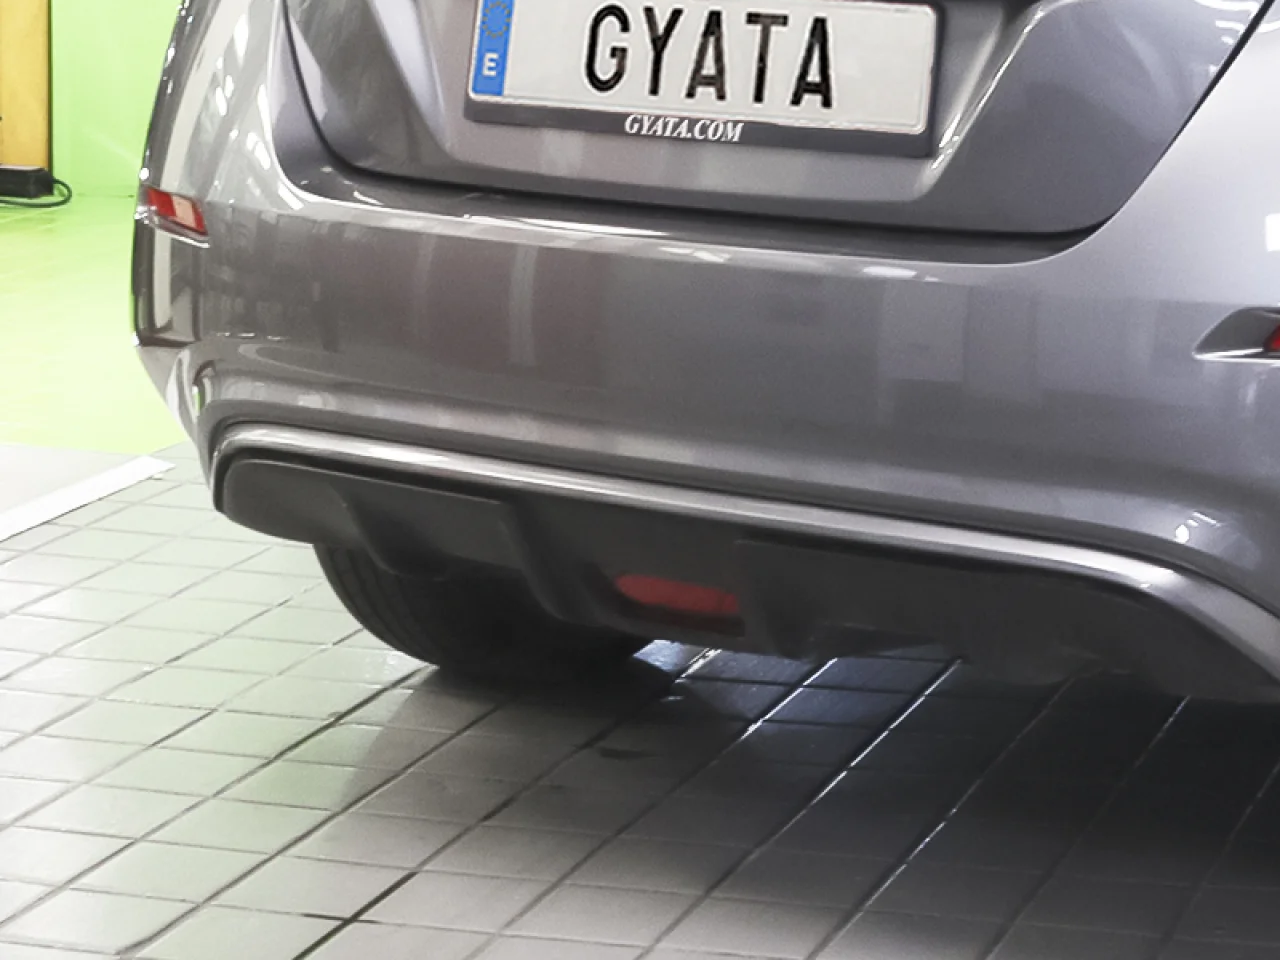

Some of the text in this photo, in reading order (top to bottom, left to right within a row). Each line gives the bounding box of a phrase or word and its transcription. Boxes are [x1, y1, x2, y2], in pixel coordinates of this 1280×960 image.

[483, 52, 498, 77] E
[584, 4, 833, 109] GYATA
[624, 113, 745, 142] GYATA.COM
